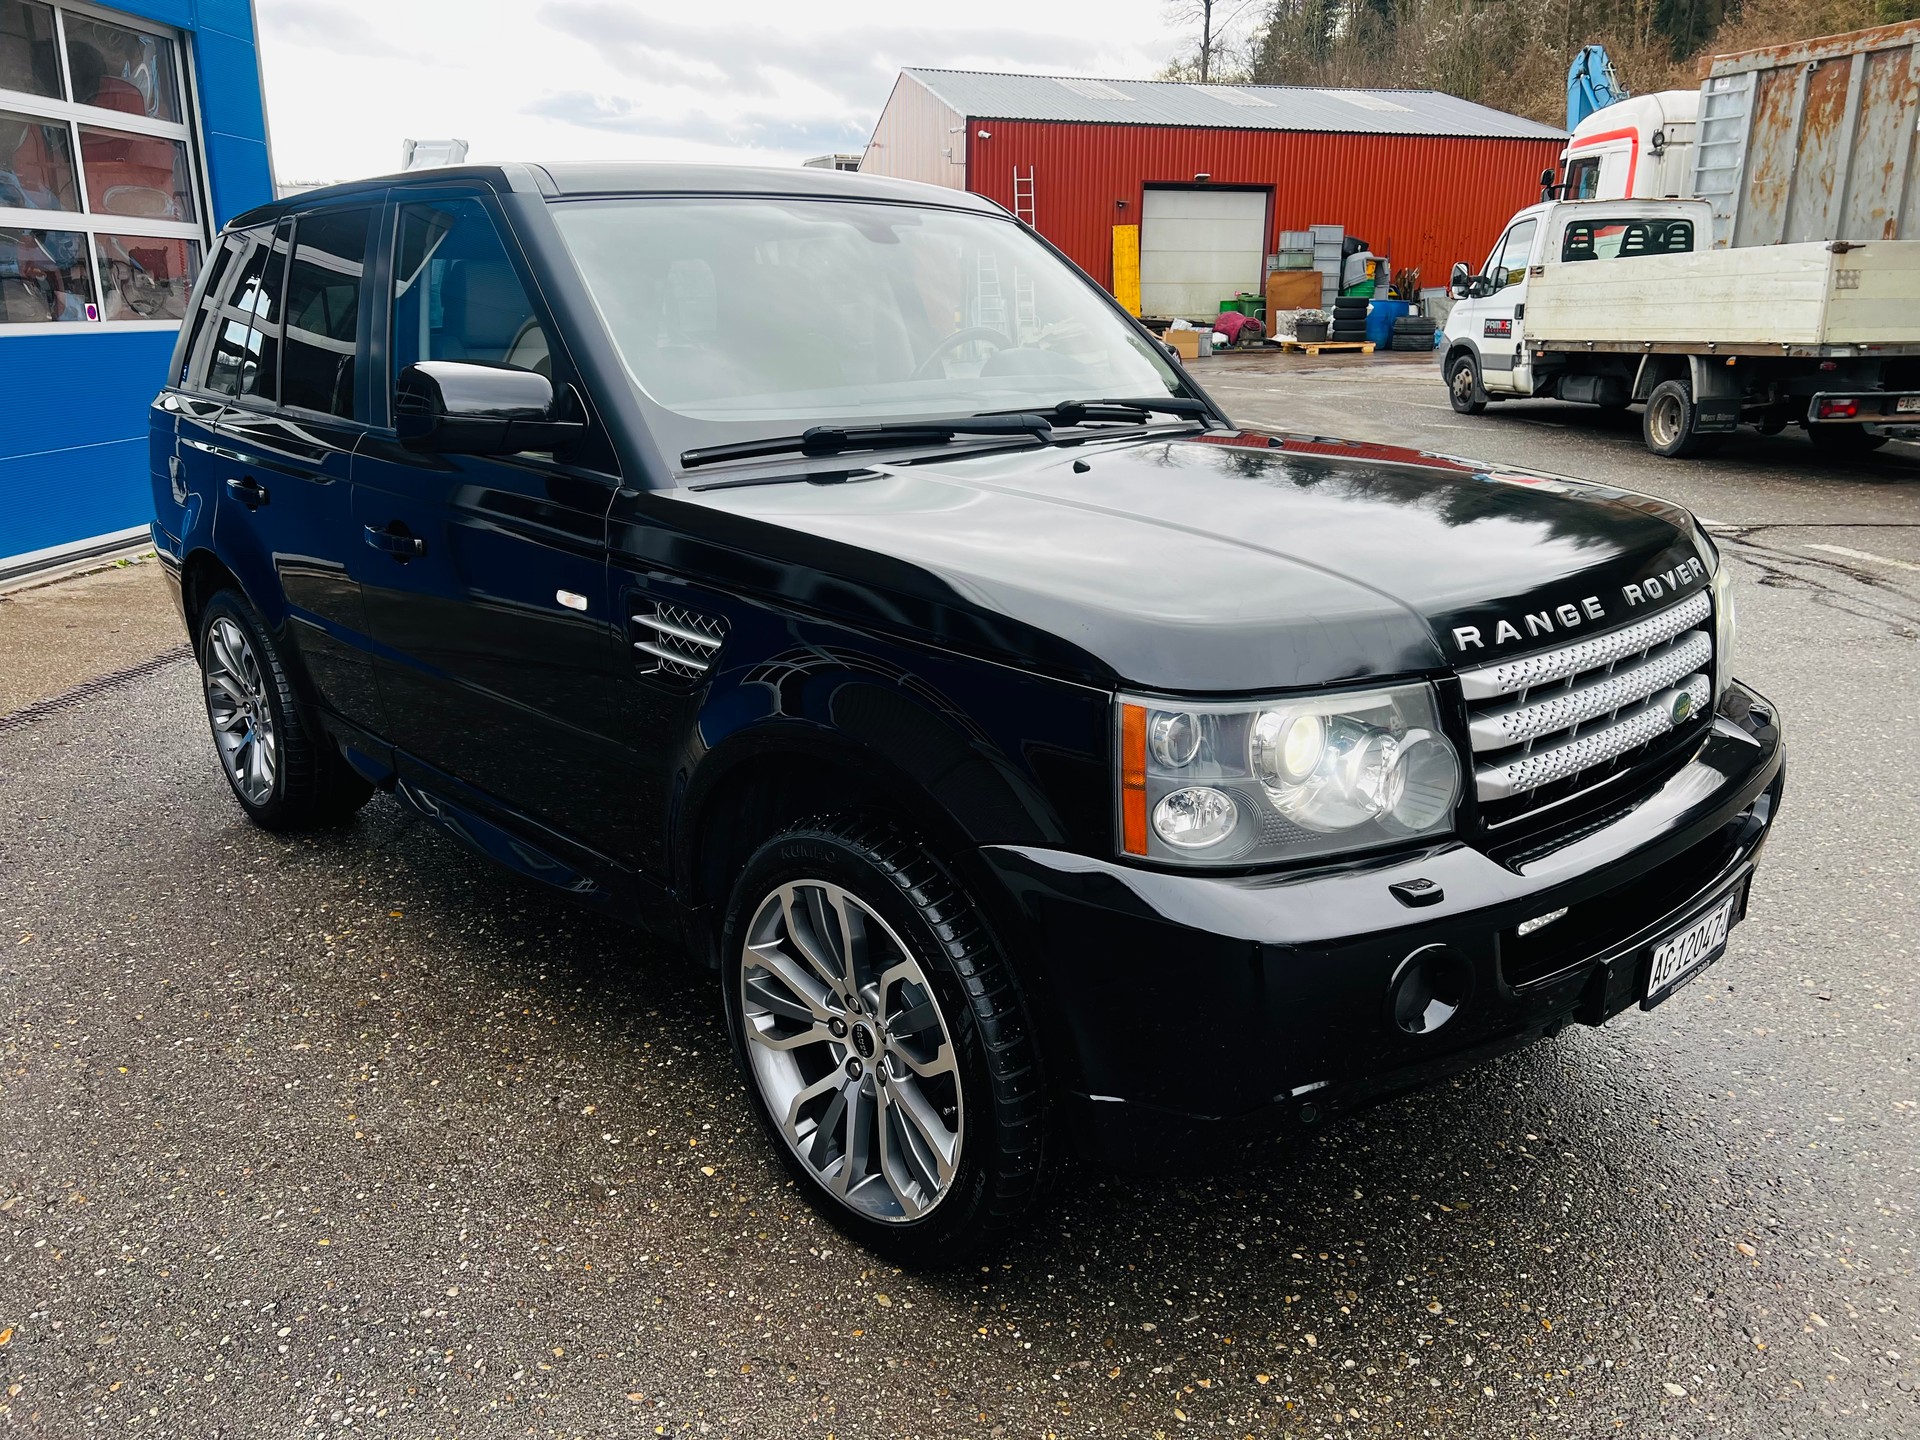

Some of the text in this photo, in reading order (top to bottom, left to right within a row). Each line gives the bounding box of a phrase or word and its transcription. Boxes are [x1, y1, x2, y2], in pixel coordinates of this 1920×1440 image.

[1485, 320, 1511, 329] PAMOS
[1452, 555, 1705, 652] RANGE ROVER
